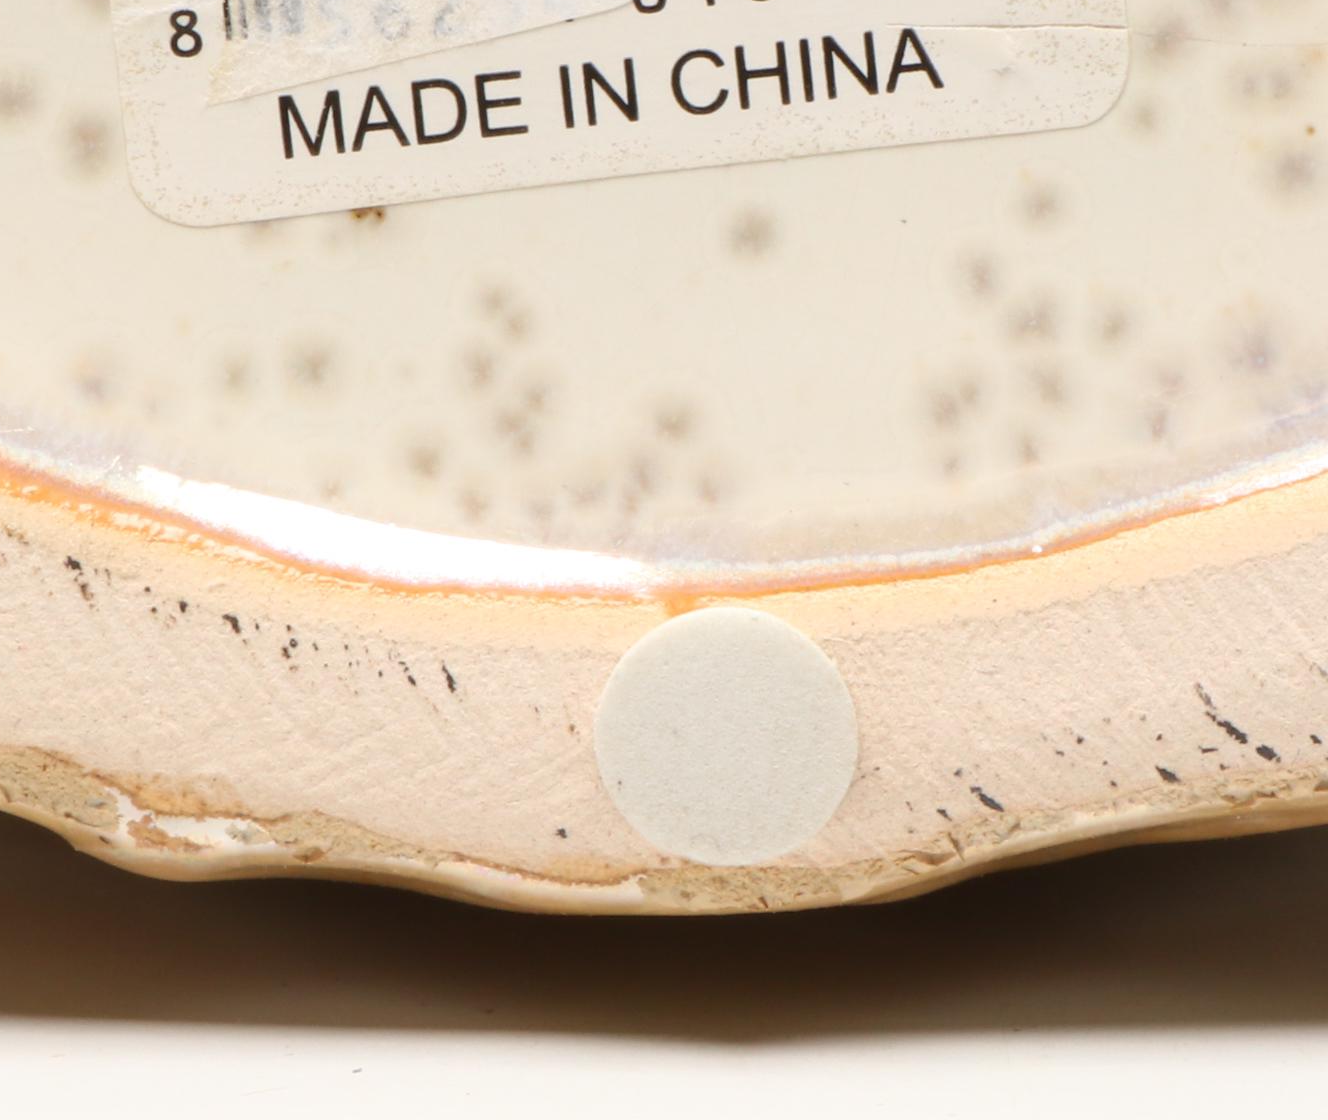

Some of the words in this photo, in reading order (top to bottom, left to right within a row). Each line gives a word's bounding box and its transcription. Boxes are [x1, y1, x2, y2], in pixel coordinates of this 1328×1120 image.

[169, 9, 203, 58] 8
[278, 70, 529, 159] MADE
[559, 58, 640, 129] IN
[671, 28, 945, 116] CHINA
